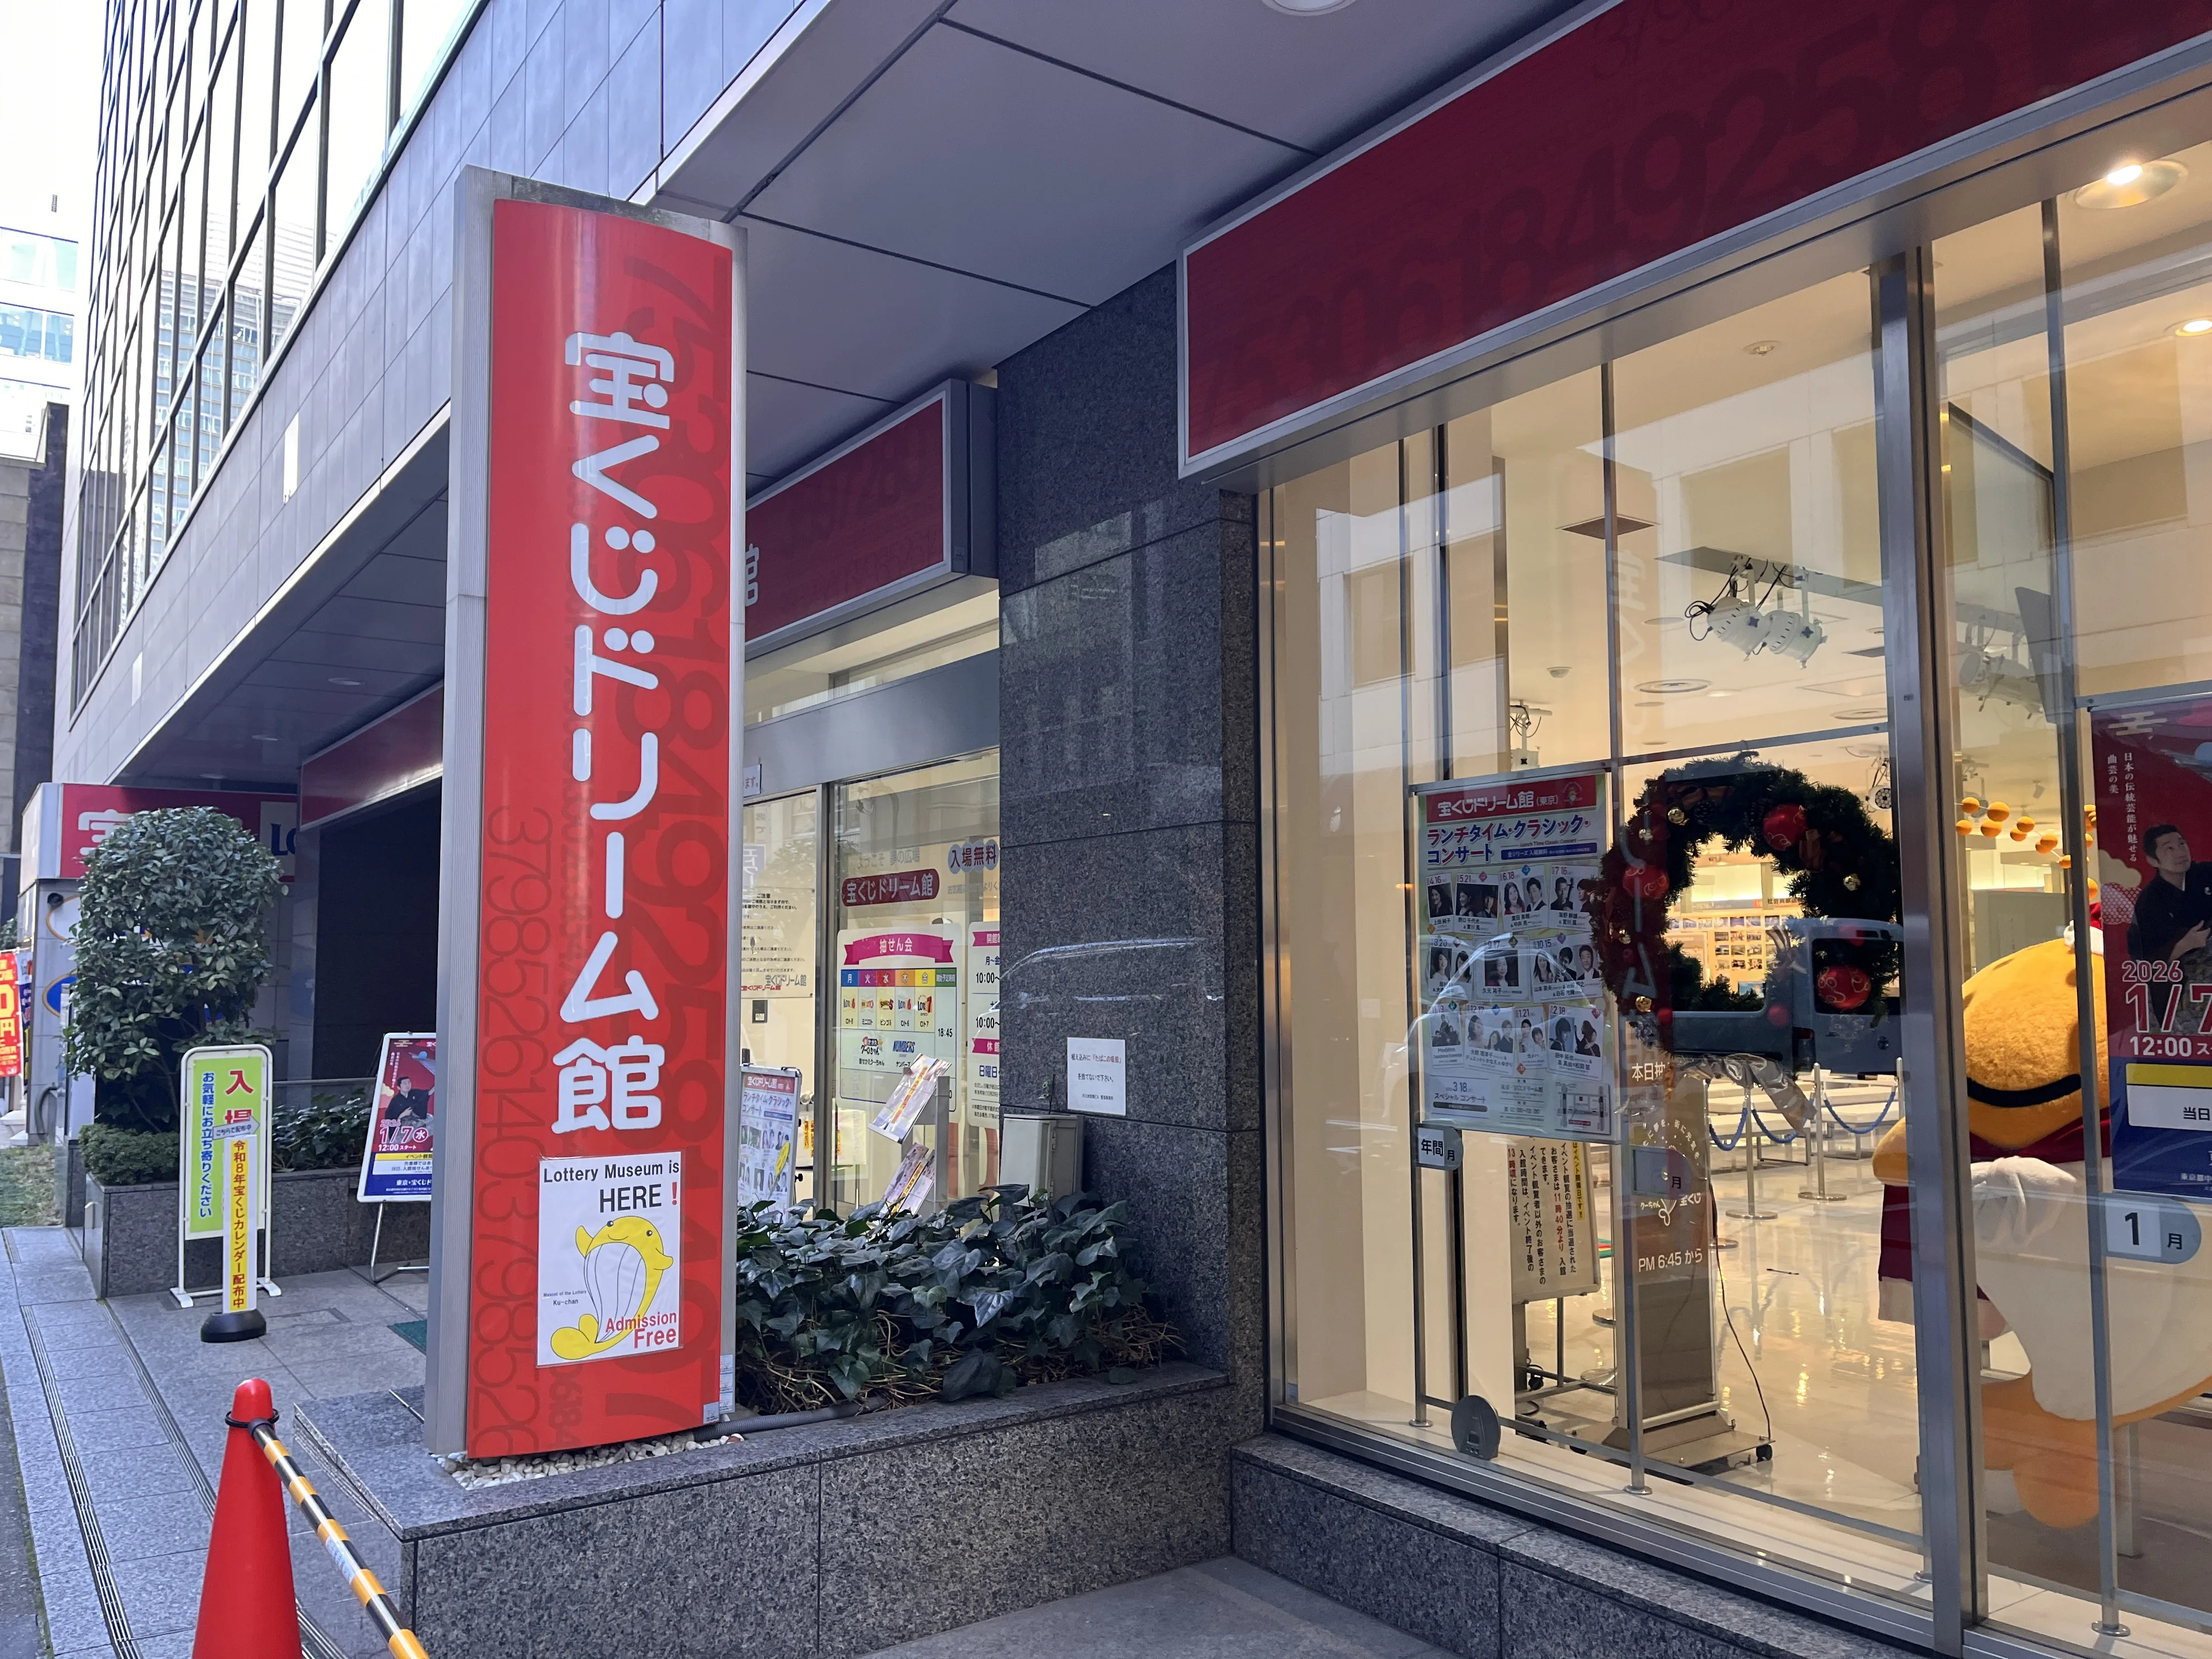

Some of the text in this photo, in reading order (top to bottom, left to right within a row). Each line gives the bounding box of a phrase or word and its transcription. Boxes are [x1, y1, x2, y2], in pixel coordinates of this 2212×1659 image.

[551, 331, 675, 1135] 宝くじドリーム館
[743, 777, 758, 788] ます。
[2108, 754, 2119, 794] 曲芸の美
[1437, 791, 1534, 817] 宝くじドリーム館
[2124, 752, 2137, 862] 日本の伝統芸能が魅せる
[951, 844, 996, 868] 入場無料
[1427, 843, 1493, 864] コンサート
[847, 873, 933, 903] 宝くじドリーム館
[879, 937, 912, 954] 抽せん会
[765, 974, 806, 986] 宝くじドリーム館
[847, 973, 853, 984] 月
[865, 973, 871, 984] 火
[883, 973, 889, 984] 水
[901, 973, 909, 984] 木
[922, 972, 929, 984] 金
[2122, 960, 2183, 982] 2026
[2125, 983, 2212, 1034] 1/7
[938, 1028, 953, 1037] 18:45
[2130, 1036, 2212, 1057] 12:00 ス
[979, 1065, 997, 1078] 日曜日
[743, 1104, 762, 1117] コンサート
[2183, 1107, 2210, 1121] 当日
[200, 1072, 215, 1218] お気軽にお立ち寄りください
[380, 1126, 427, 1144] 1/7 水
[1421, 1138, 1455, 1161] 年間 月
[544, 1159, 680, 1183] Lottery Museum is
[1541, 1148, 1550, 1186] できます。
[1672, 1176, 1681, 1189] 月
[599, 1181, 678, 1213] HERE !
[1640, 1201, 1661, 1210] クーちゃん
[232, 1139, 247, 1308] 令和8年宝くじカレンダー配布中
[2124, 1212, 2182, 1250] 1 月
[1638, 1247, 1702, 1272] PM 6:45 から
[553, 1297, 579, 1306] Ku-chan
[606, 1311, 677, 1333] Admission
[634, 1327, 676, 1349] Free
